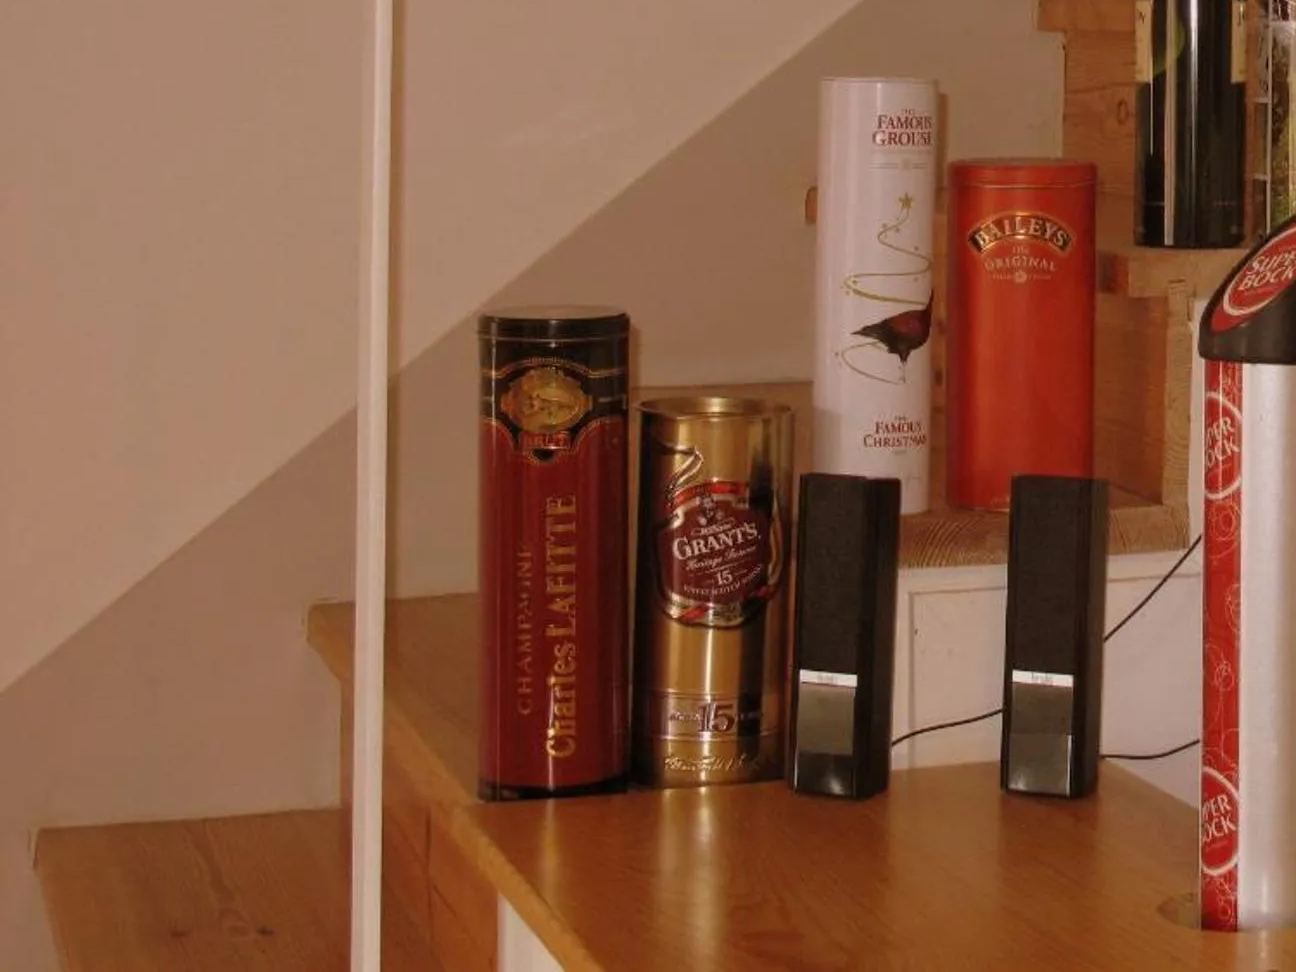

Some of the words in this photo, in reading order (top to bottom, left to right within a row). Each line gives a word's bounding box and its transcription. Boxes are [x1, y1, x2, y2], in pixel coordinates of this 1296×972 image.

[877, 114, 933, 130] FAMOUS
[974, 216, 1067, 247] BAILEYS
[985, 255, 1056, 271] ORIGINAL
[1238, 266, 1294, 290] BOCK
[1206, 435, 1240, 468] OCK
[545, 494, 576, 637] LAFITTE
[716, 569, 733, 585] 15
[546, 641, 576, 759] Charles
[698, 702, 736, 733] 15
[1202, 813, 1237, 843] OCK
